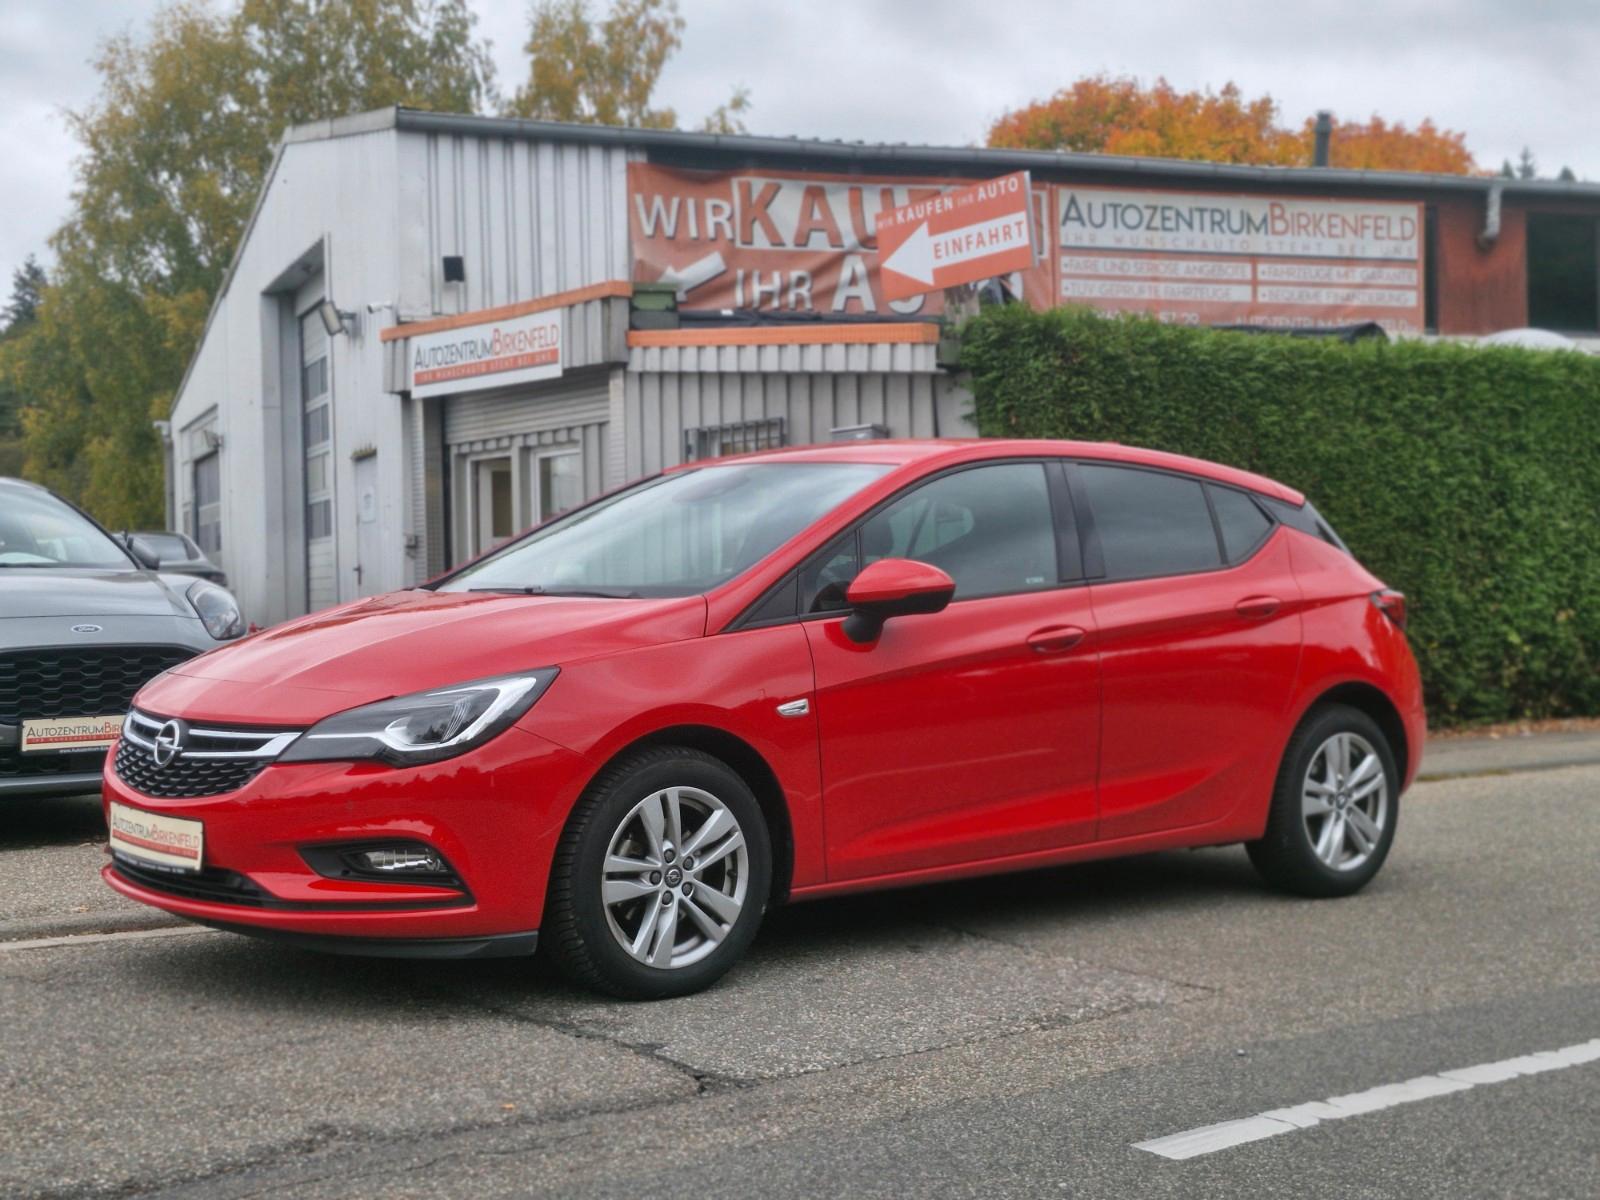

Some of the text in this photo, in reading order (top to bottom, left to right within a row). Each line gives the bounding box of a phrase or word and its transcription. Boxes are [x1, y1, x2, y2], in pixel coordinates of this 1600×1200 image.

[635, 192, 733, 241] WIR
[896, 196, 954, 225] KAUFEN
[977, 177, 1019, 202] AUTO
[933, 220, 1025, 260] EINFAHRT
[735, 267, 812, 311] IHR
[27, 722, 121, 737] AUTOZENTRUMBIR
